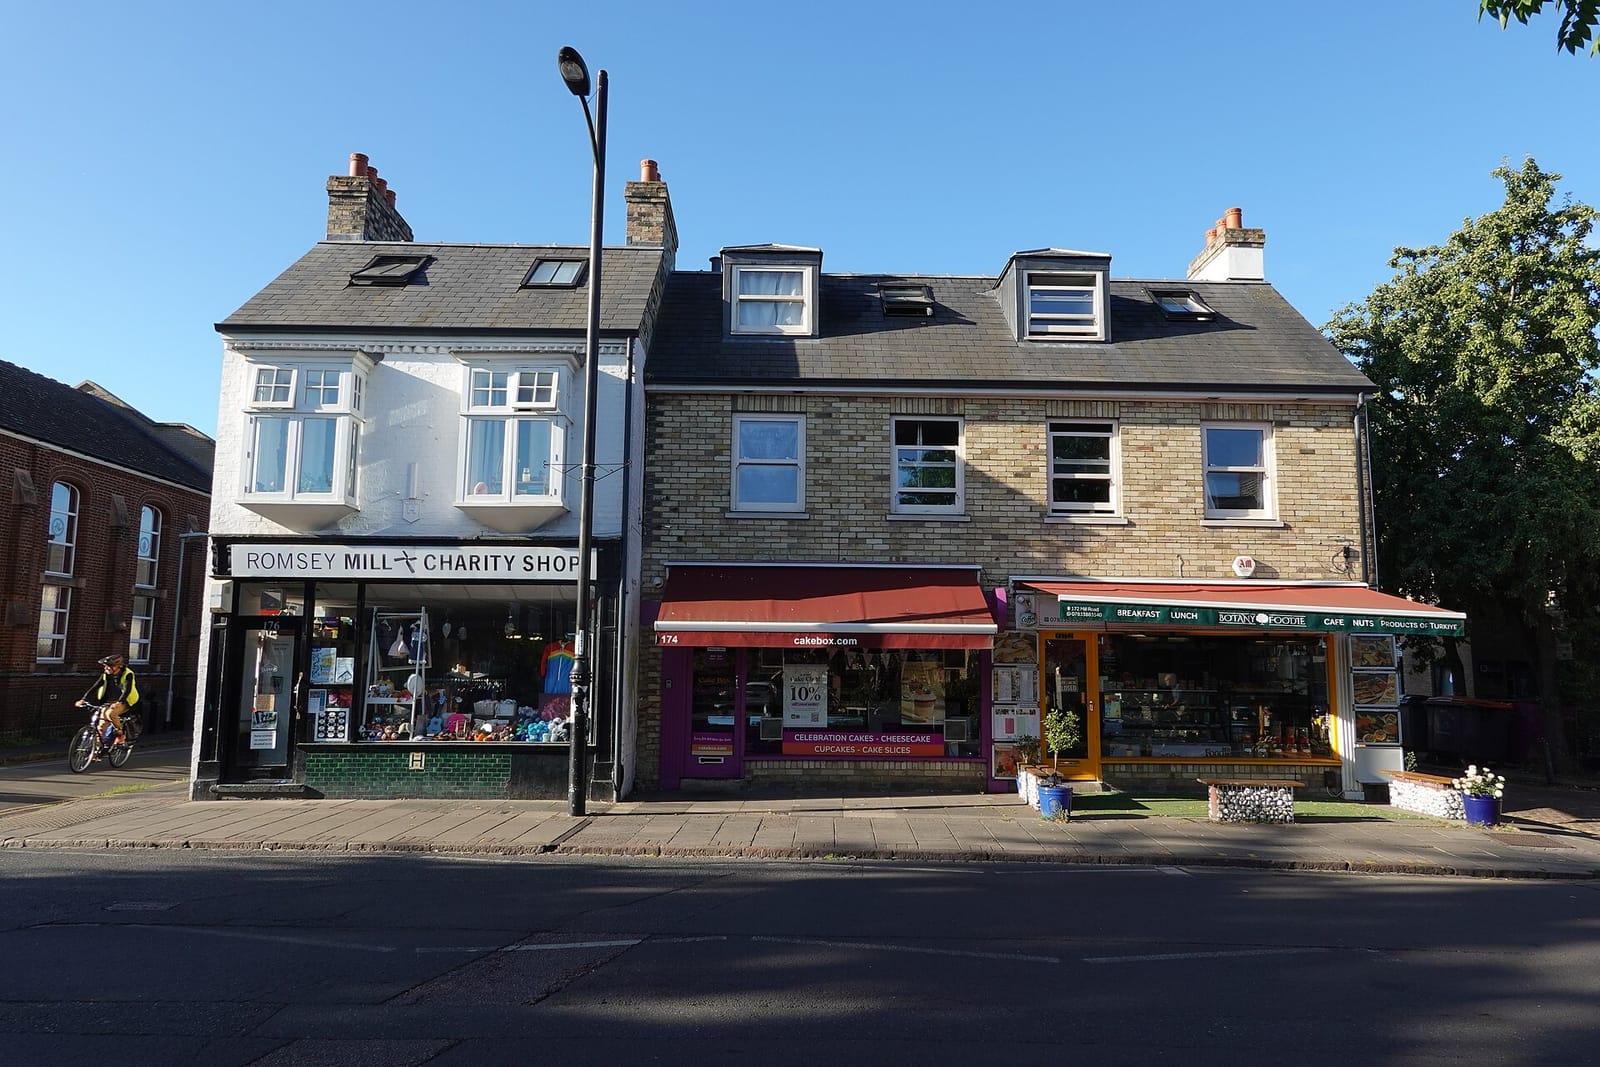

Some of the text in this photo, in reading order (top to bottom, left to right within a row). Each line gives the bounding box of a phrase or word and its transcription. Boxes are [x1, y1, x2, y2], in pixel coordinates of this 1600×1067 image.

[247, 552, 579, 572] ROMSEY MILL CHARITY SHOP
[1117, 609, 1198, 620] BREAKFAST LUNCH
[1218, 613, 1306, 625] BOTANY FOODIE
[263, 620, 281, 631] 176
[1323, 618, 1345, 626] CAFE
[1352, 619, 1375, 627] NUTS
[1380, 620, 1418, 629] PRODUCTS
[661, 635, 858, 646] 174 cakebox.com
[790, 686, 821, 702] 10%
[794, 733, 847, 742] CELEBRATION
[848, 734, 874, 742] CAKES
[880, 735, 931, 743] CHEESECAKE
[814, 745, 856, 753] CUPCAKES
